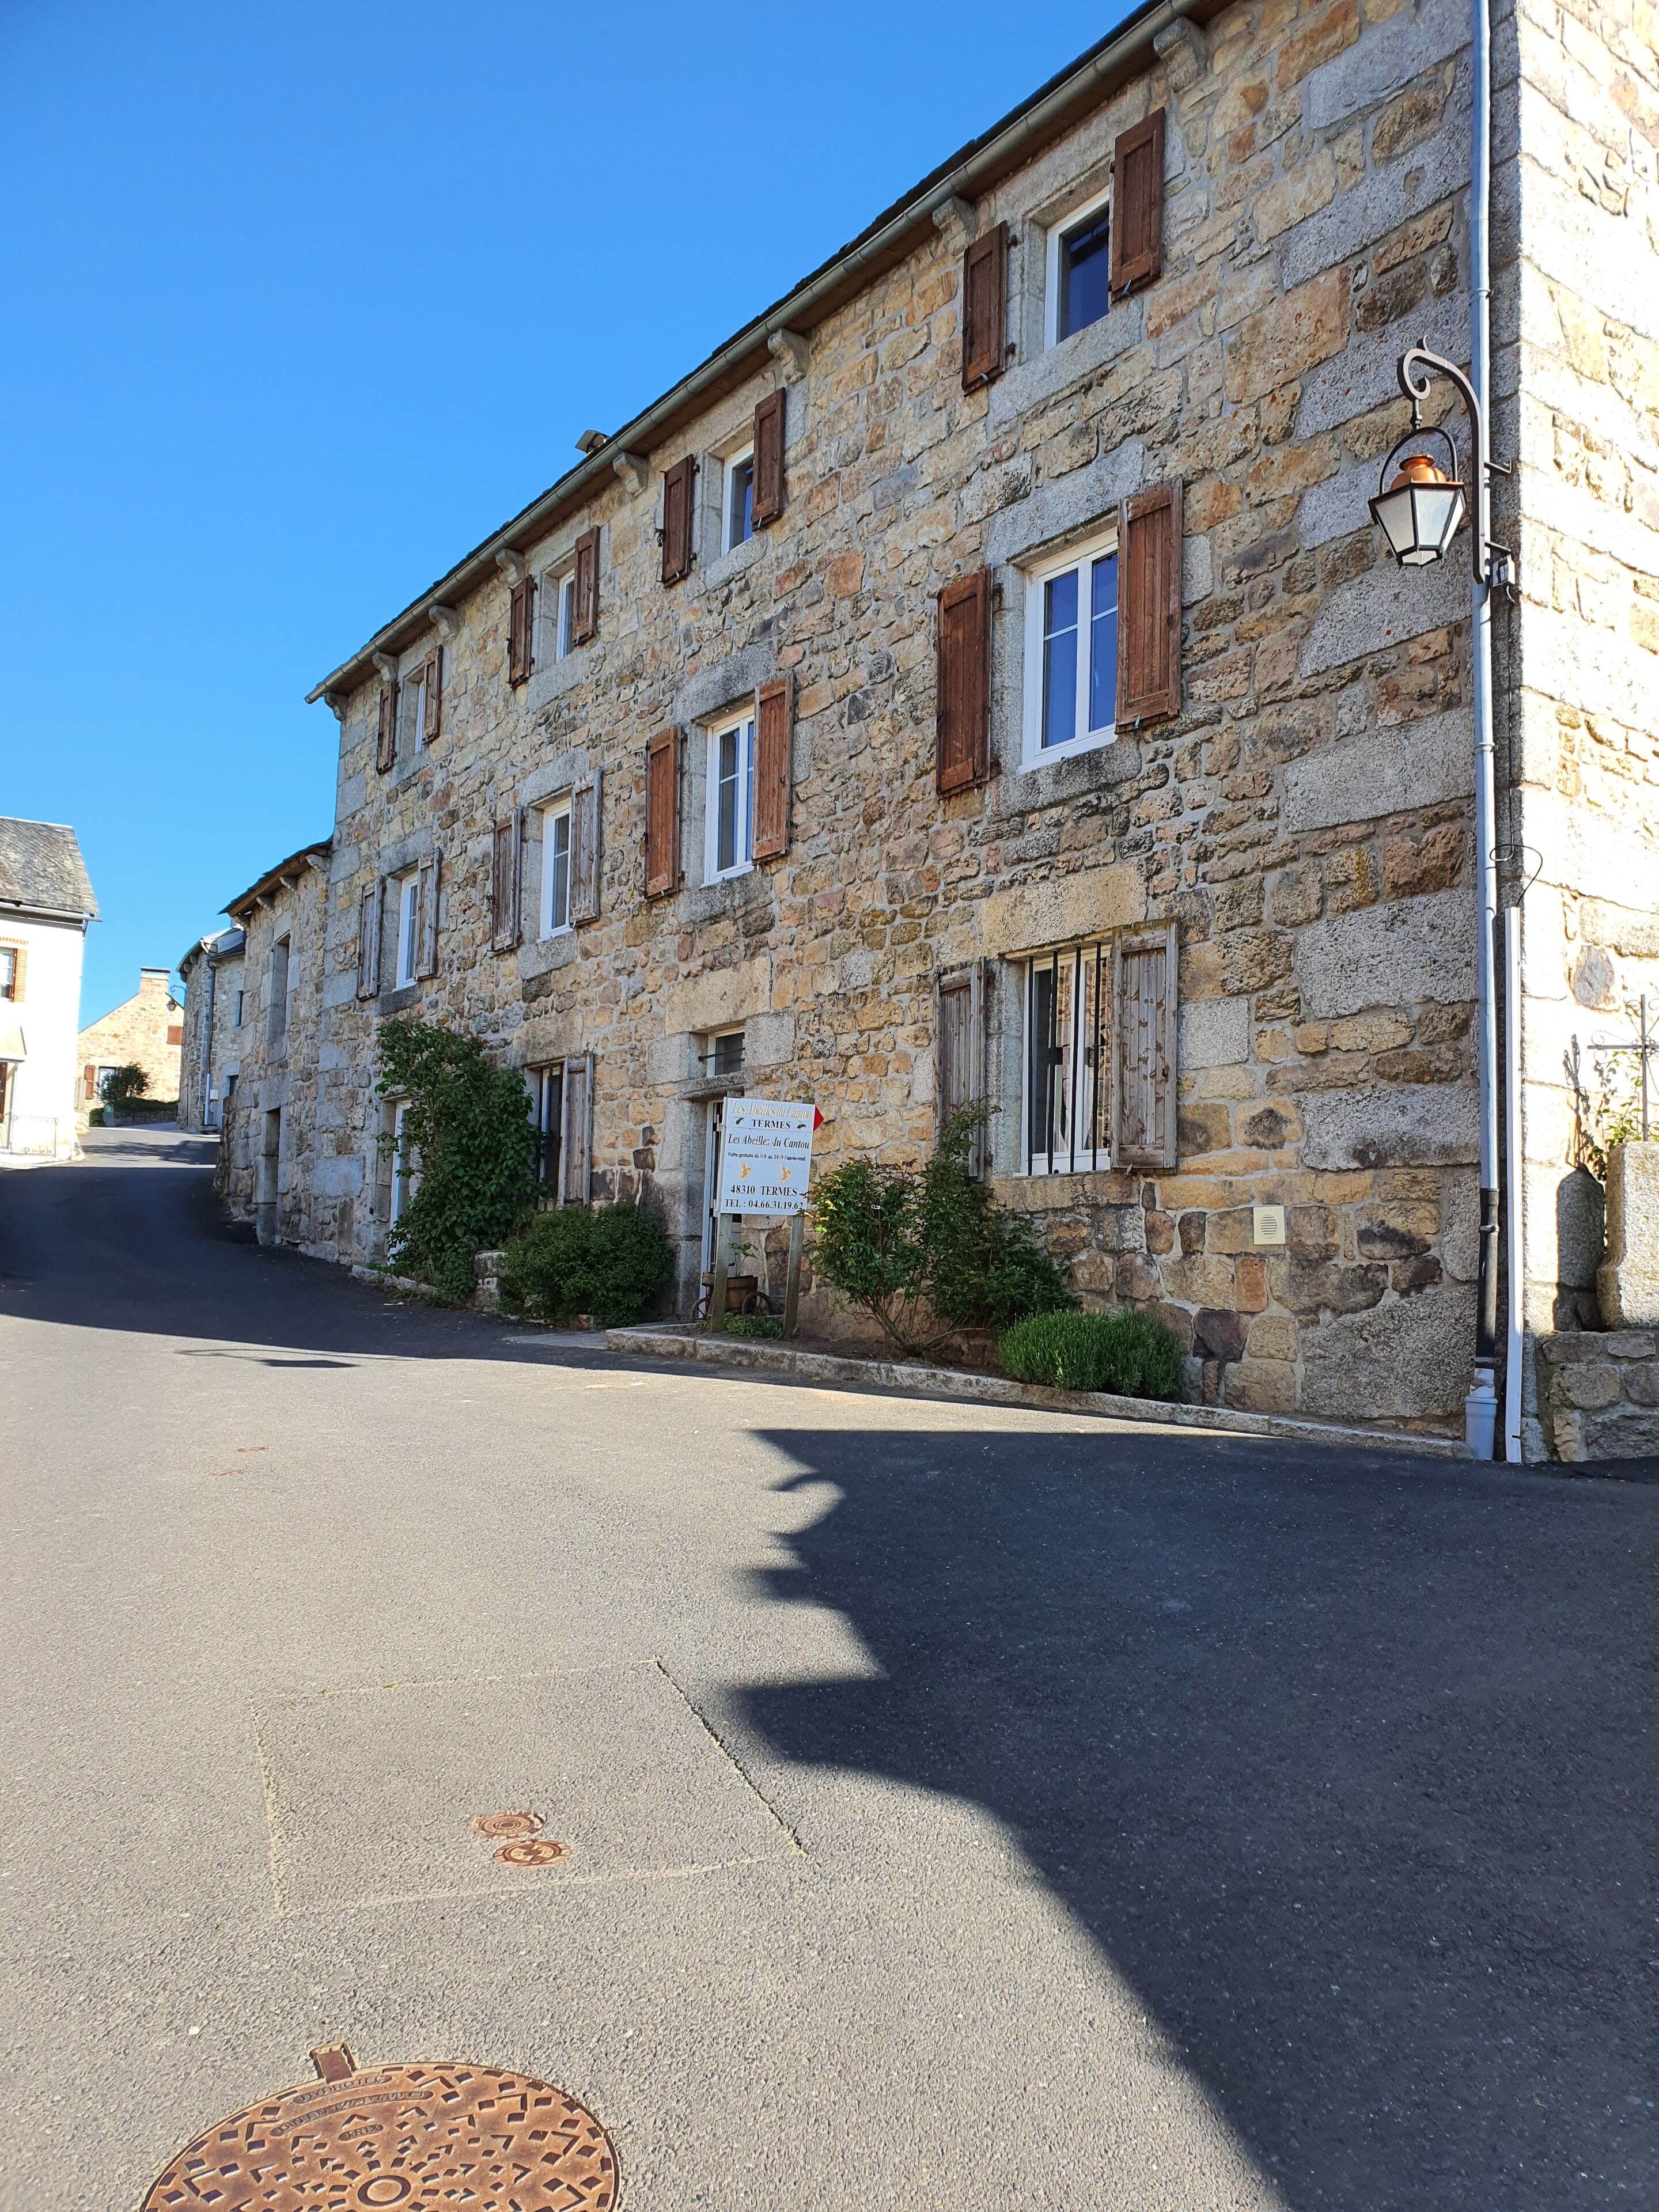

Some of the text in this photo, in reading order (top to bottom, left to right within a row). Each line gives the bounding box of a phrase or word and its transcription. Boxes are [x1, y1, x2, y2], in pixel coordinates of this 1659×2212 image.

[732, 1100, 812, 1119] Les Abeilles du Cantou
[752, 1119, 791, 1129] TERMES
[728, 1134, 810, 1149] Les Abeilles du Cantou
[730, 1184, 798, 1196] 48310 TERMES
[725, 1198, 741, 1207] TEL
[748, 1199, 803, 1210] 04.66.31.19.62
